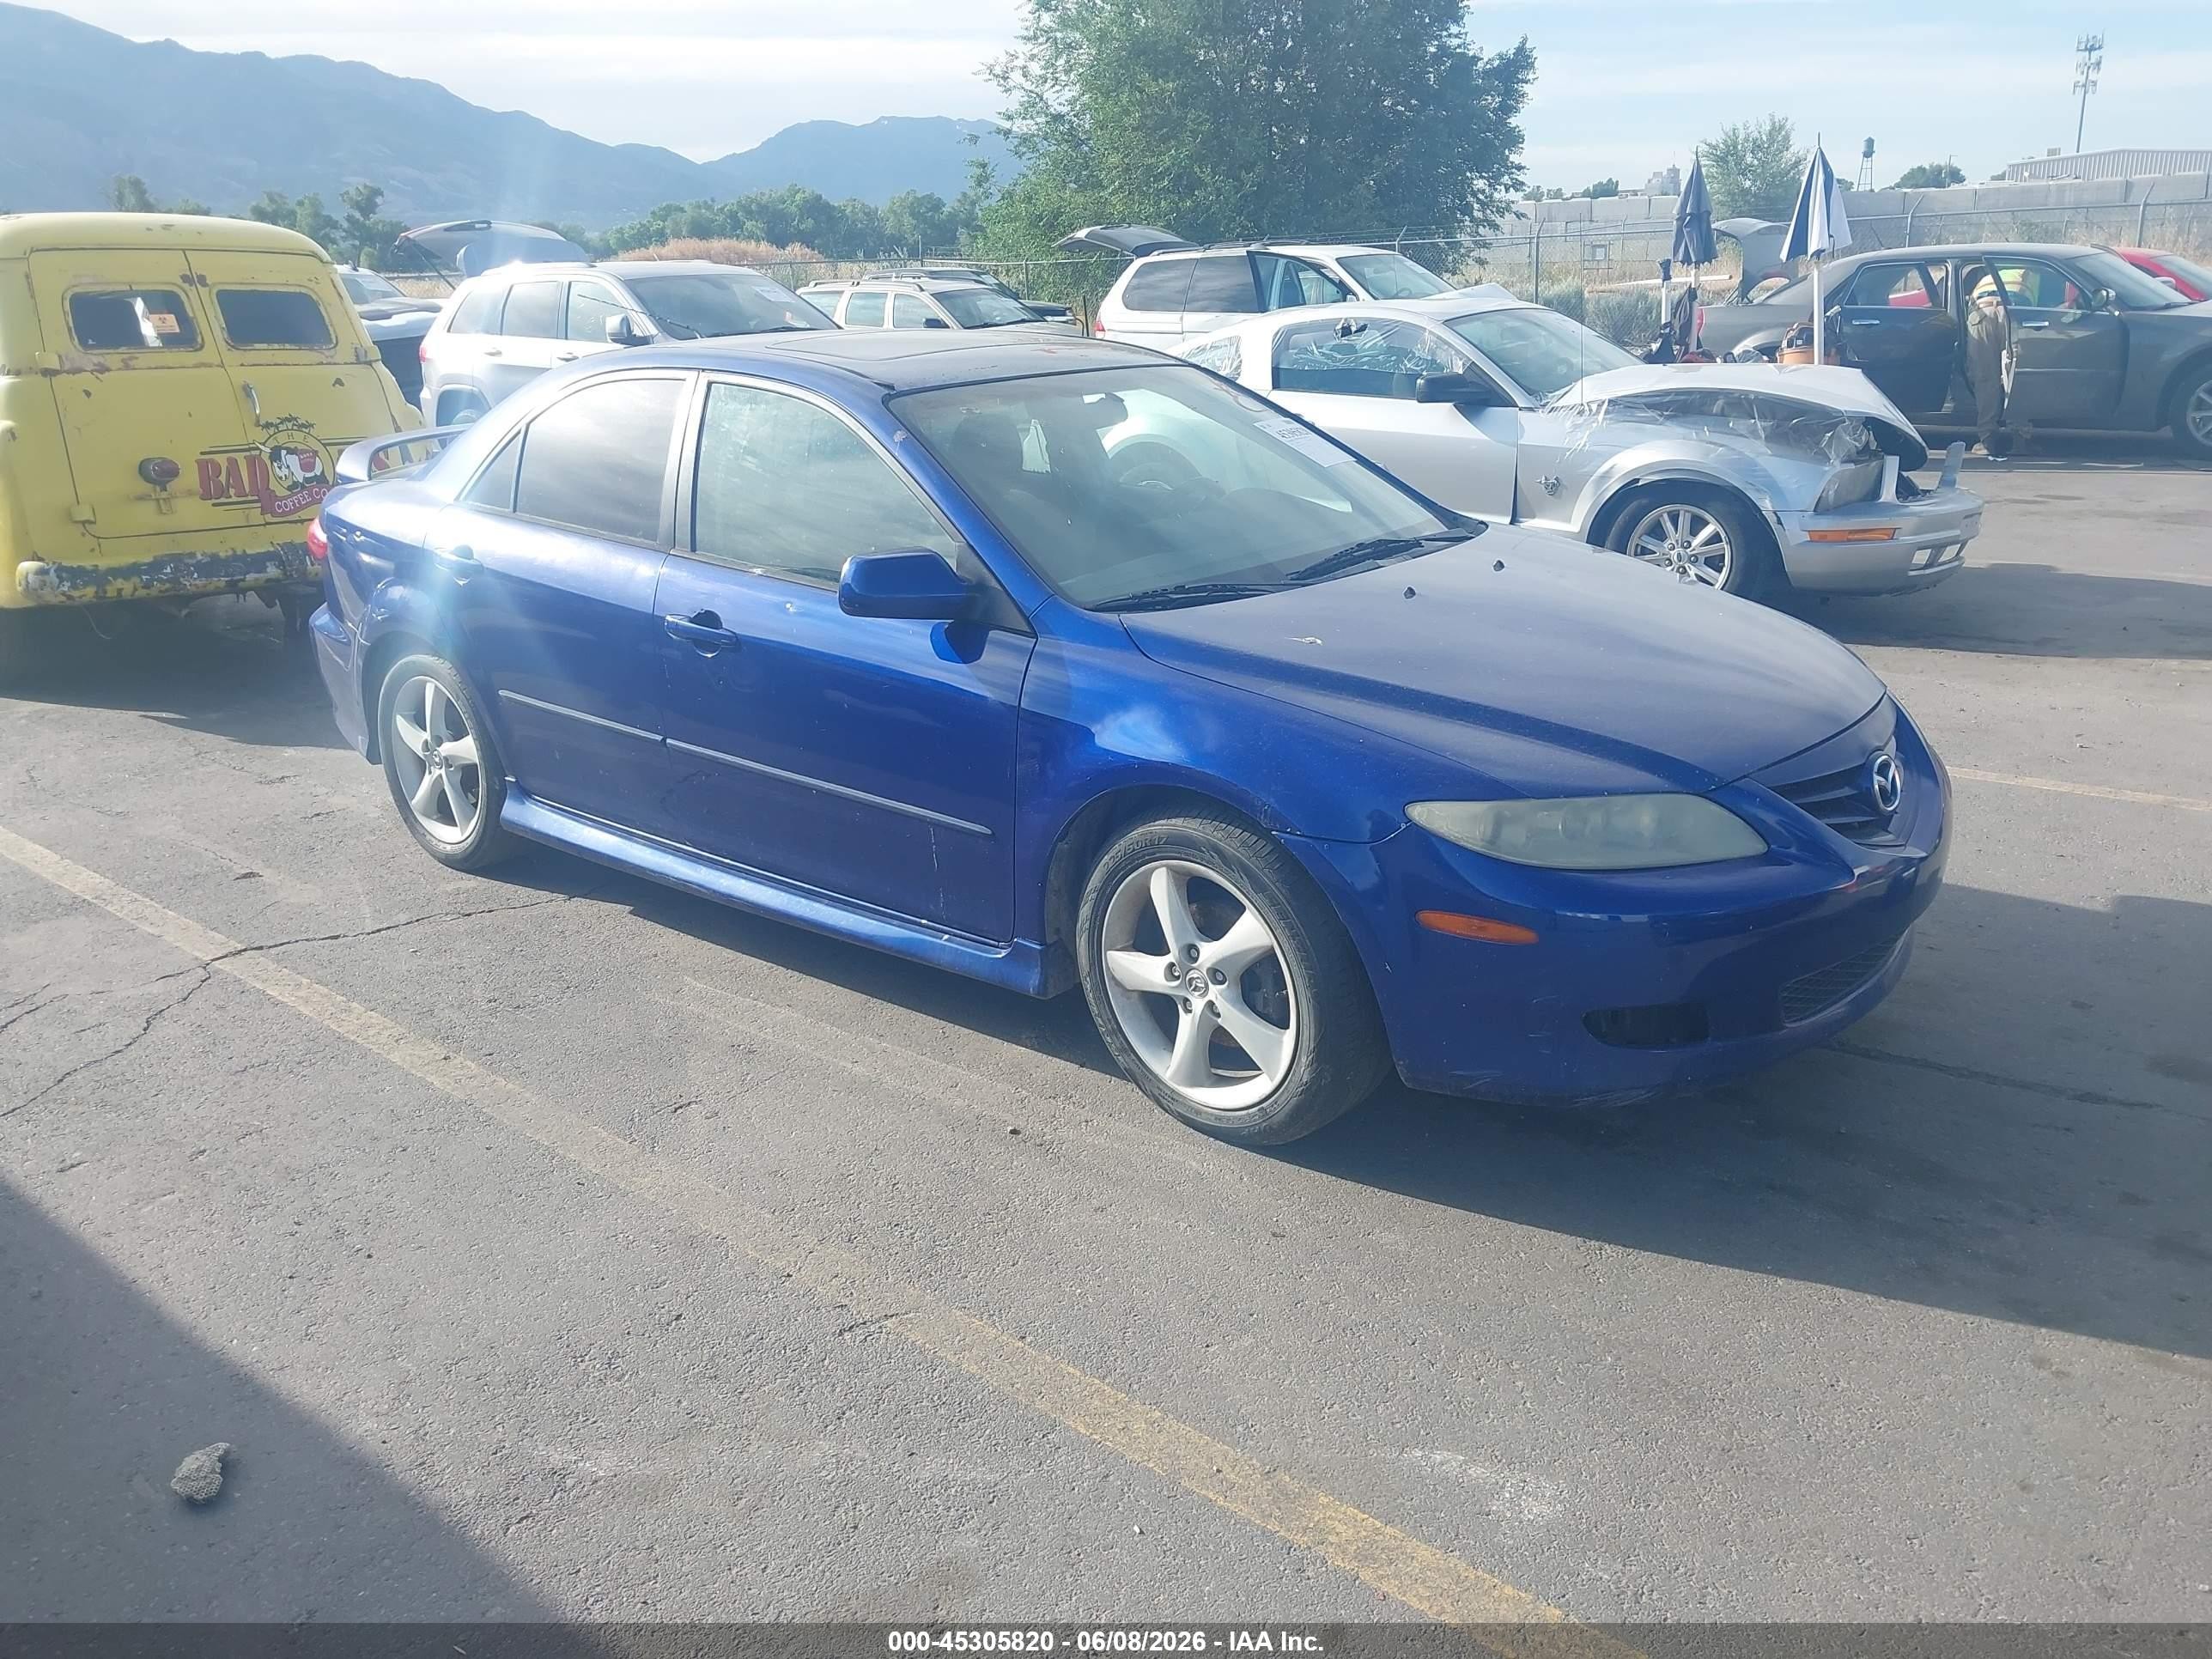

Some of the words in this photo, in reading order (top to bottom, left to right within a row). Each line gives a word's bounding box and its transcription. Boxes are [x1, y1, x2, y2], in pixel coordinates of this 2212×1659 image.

[272, 432, 309, 445] THE
[195, 453, 270, 501] BAD
[275, 490, 312, 513] COFFEE
